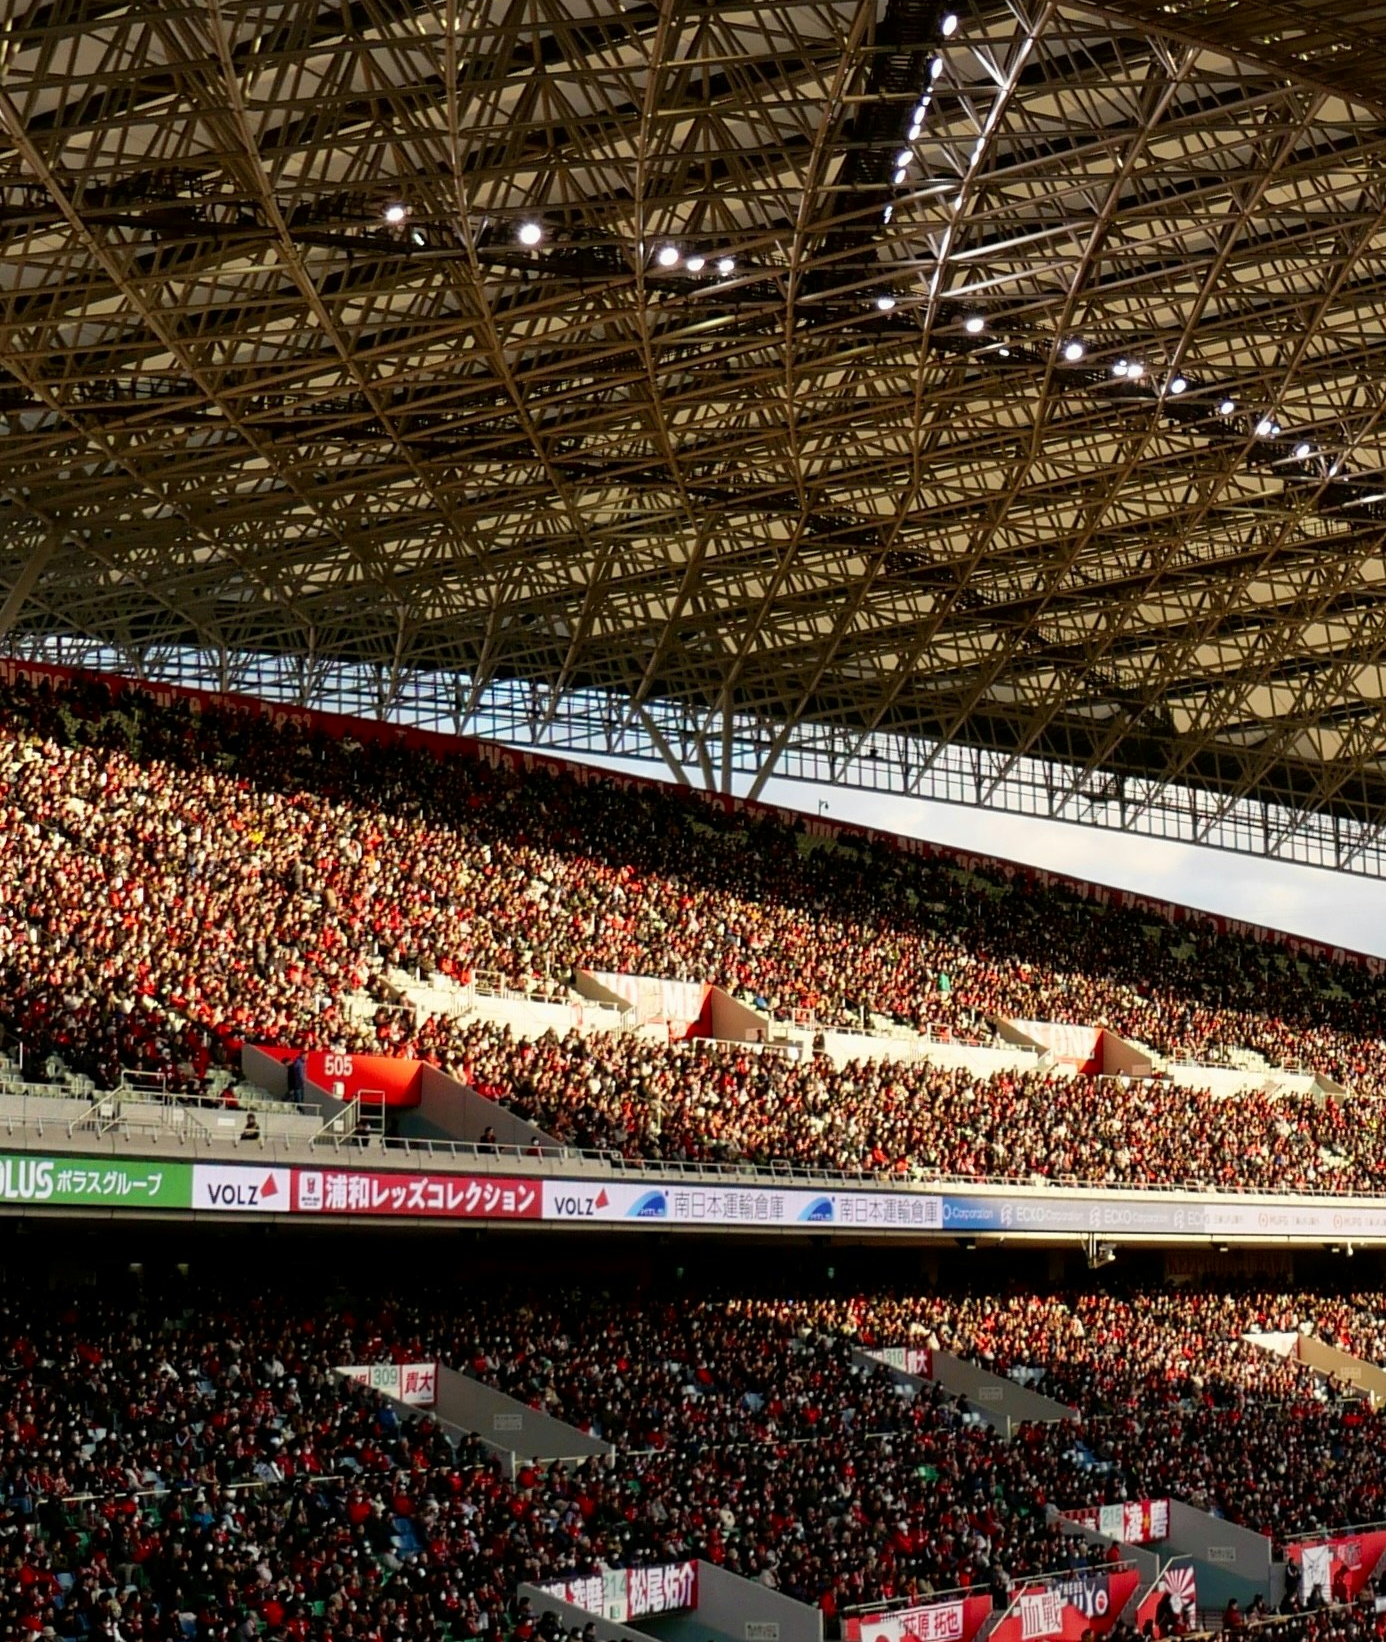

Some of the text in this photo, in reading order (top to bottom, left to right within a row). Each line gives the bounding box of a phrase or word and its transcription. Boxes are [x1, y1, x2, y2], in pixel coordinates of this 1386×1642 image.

[325, 1055, 353, 1077] 505
[57, 1169, 163, 1196] ポラスグループ
[324, 1173, 536, 1213] 浦和レッズコレクション
[208, 1183, 258, 1205] VOLZ
[554, 1196, 595, 1216] VOLZ
[673, 1191, 785, 1221] 南日本運輸倉庫
[374, 1368, 398, 1385] 309
[405, 1371, 434, 1394] 貴大
[1102, 1509, 1122, 1527] 215
[630, 1561, 696, 1615] 松尾佑介
